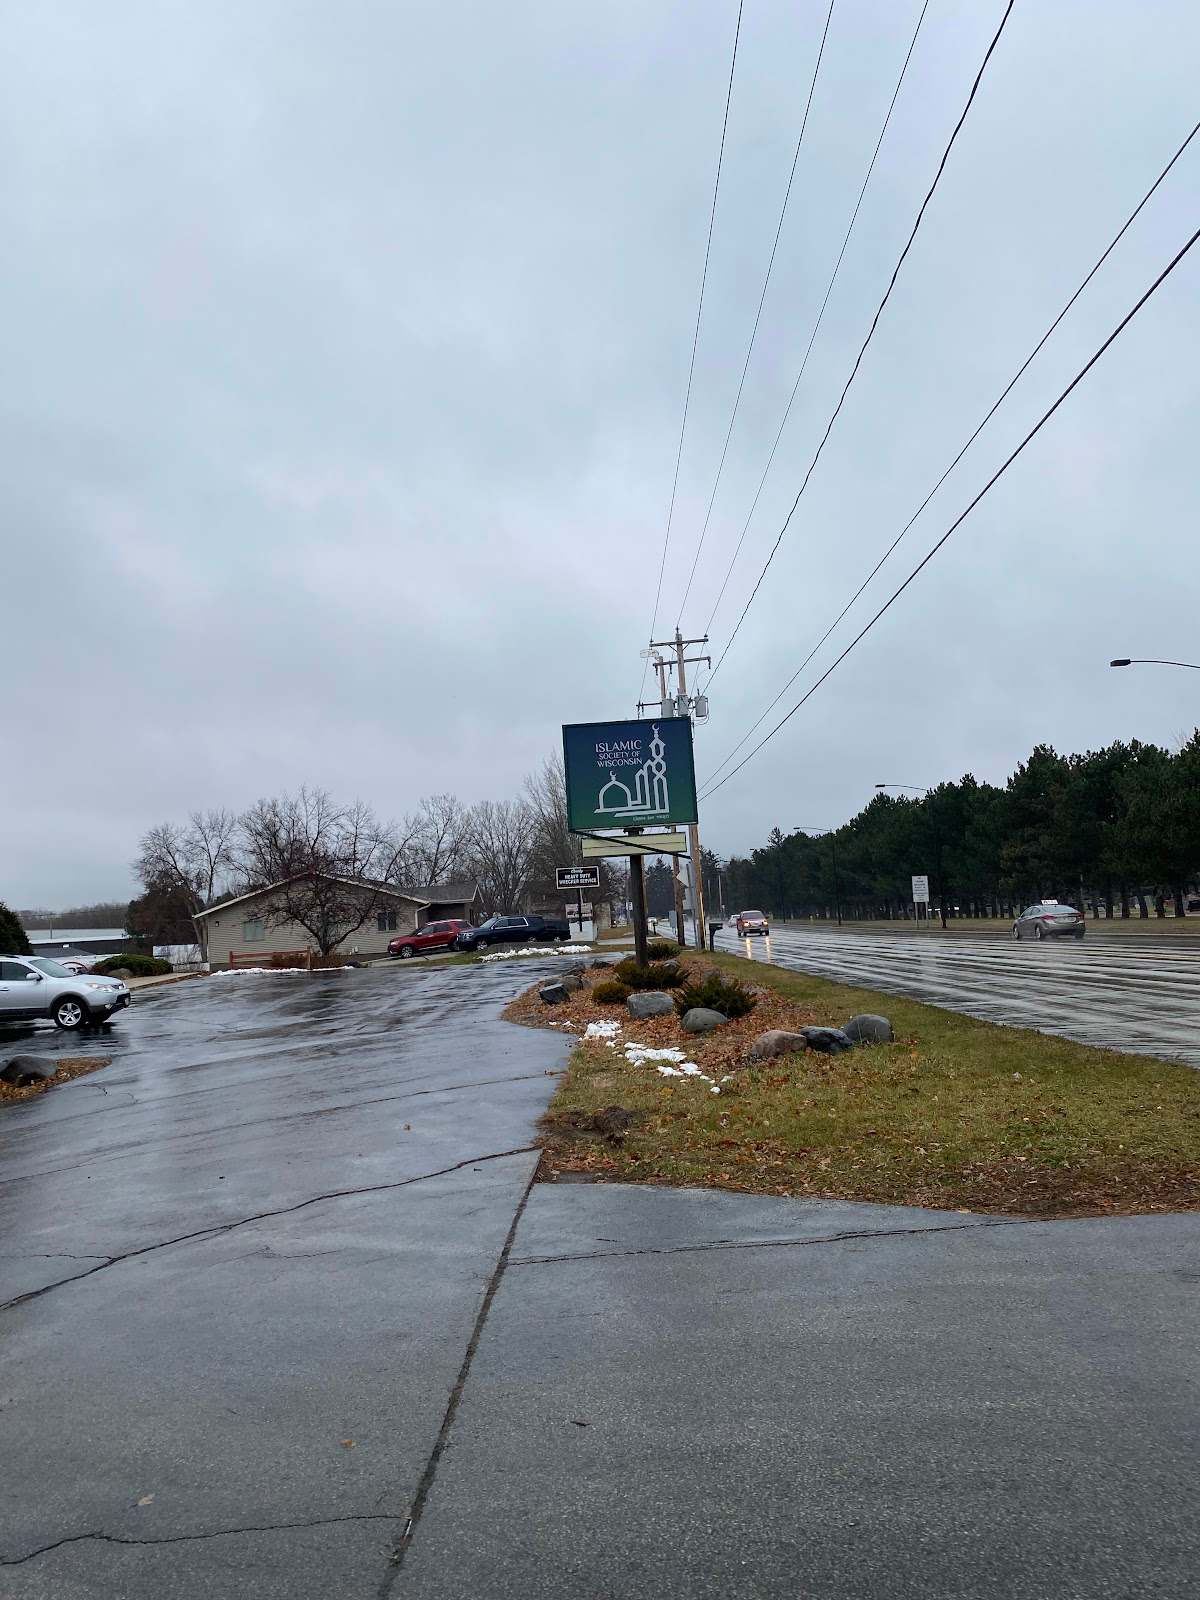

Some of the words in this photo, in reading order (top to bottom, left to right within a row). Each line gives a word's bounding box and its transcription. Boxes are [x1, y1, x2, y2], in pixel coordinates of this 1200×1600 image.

[596, 740, 642, 752] ISLAMIC
[598, 752, 629, 760] SOCIETY
[597, 758, 643, 767] WISCONSIN
